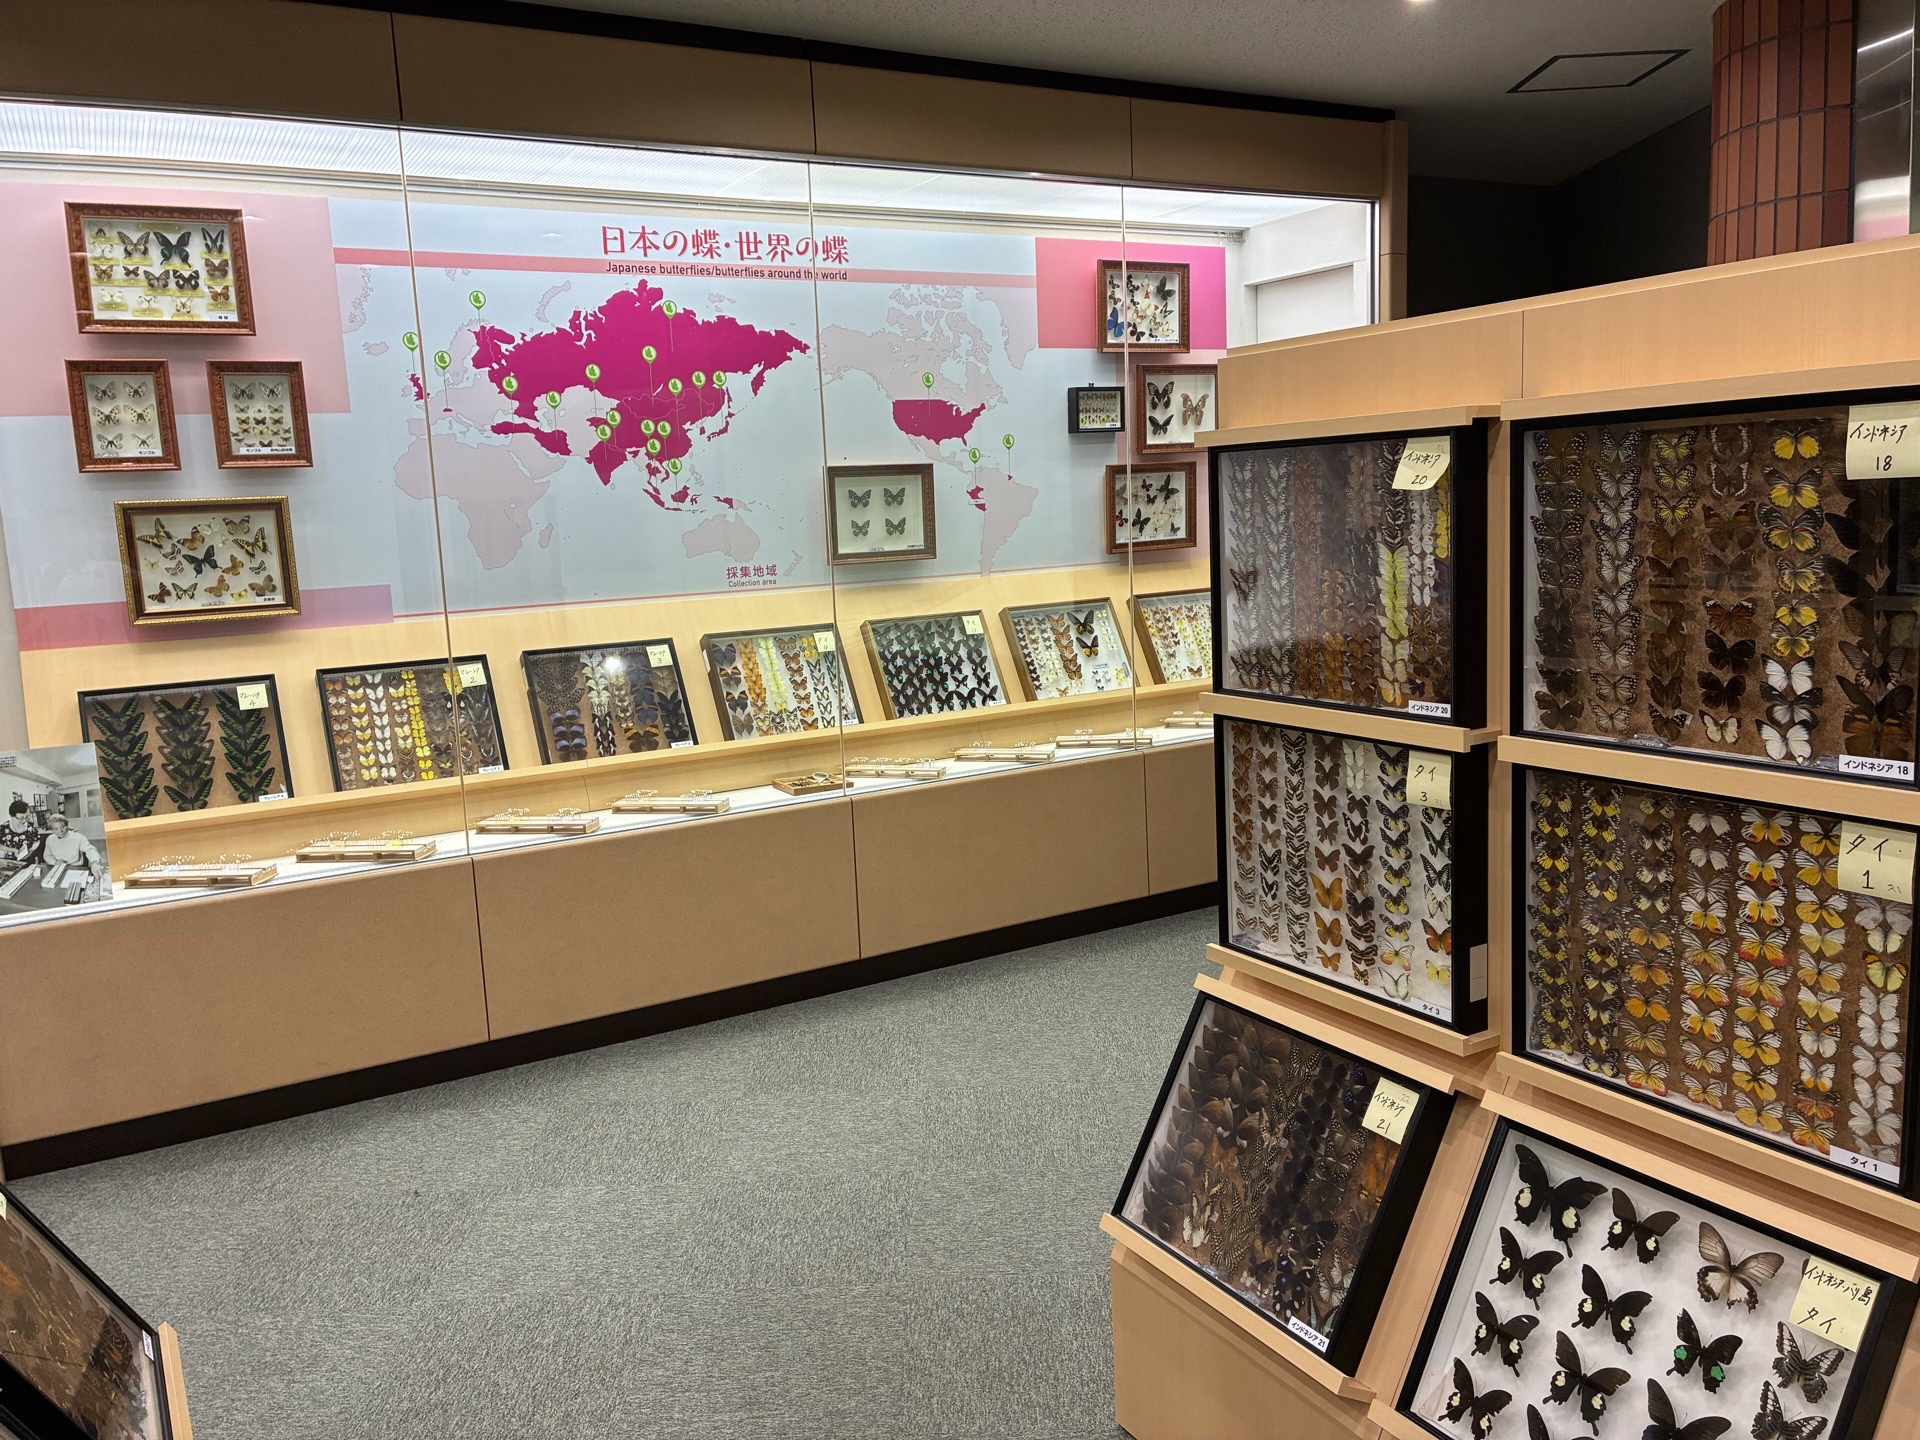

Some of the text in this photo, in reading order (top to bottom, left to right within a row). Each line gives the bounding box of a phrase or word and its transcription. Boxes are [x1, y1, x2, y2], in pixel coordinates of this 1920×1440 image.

[602, 225, 850, 265] 日本の蝶・世界の蝶
[606, 261, 657, 275] Japanese
[660, 263, 765, 278] butterflies/butterflies
[768, 268, 801, 279] around
[821, 270, 847, 280] world
[1849, 423, 1908, 444] インドネシア
[1876, 455, 1893, 472] 18
[1411, 474, 1428, 485] 20
[726, 564, 778, 580] 採集地域
[728, 580, 761, 588] Collection
[470, 676, 477, 684] 2
[1411, 703, 1449, 715] インドネシア 20
[1844, 760, 1909, 775] インドネシア 18
[1420, 791, 1428, 802] 3
[1862, 869, 1875, 890] 1
[1422, 1003, 1441, 1016] タイ 3
[1376, 1118, 1391, 1135] 21
[1850, 1156, 1878, 1172] タイ 1
[1797, 1306, 1837, 1335] タイ
[1292, 1322, 1326, 1348] インドネシア 21
